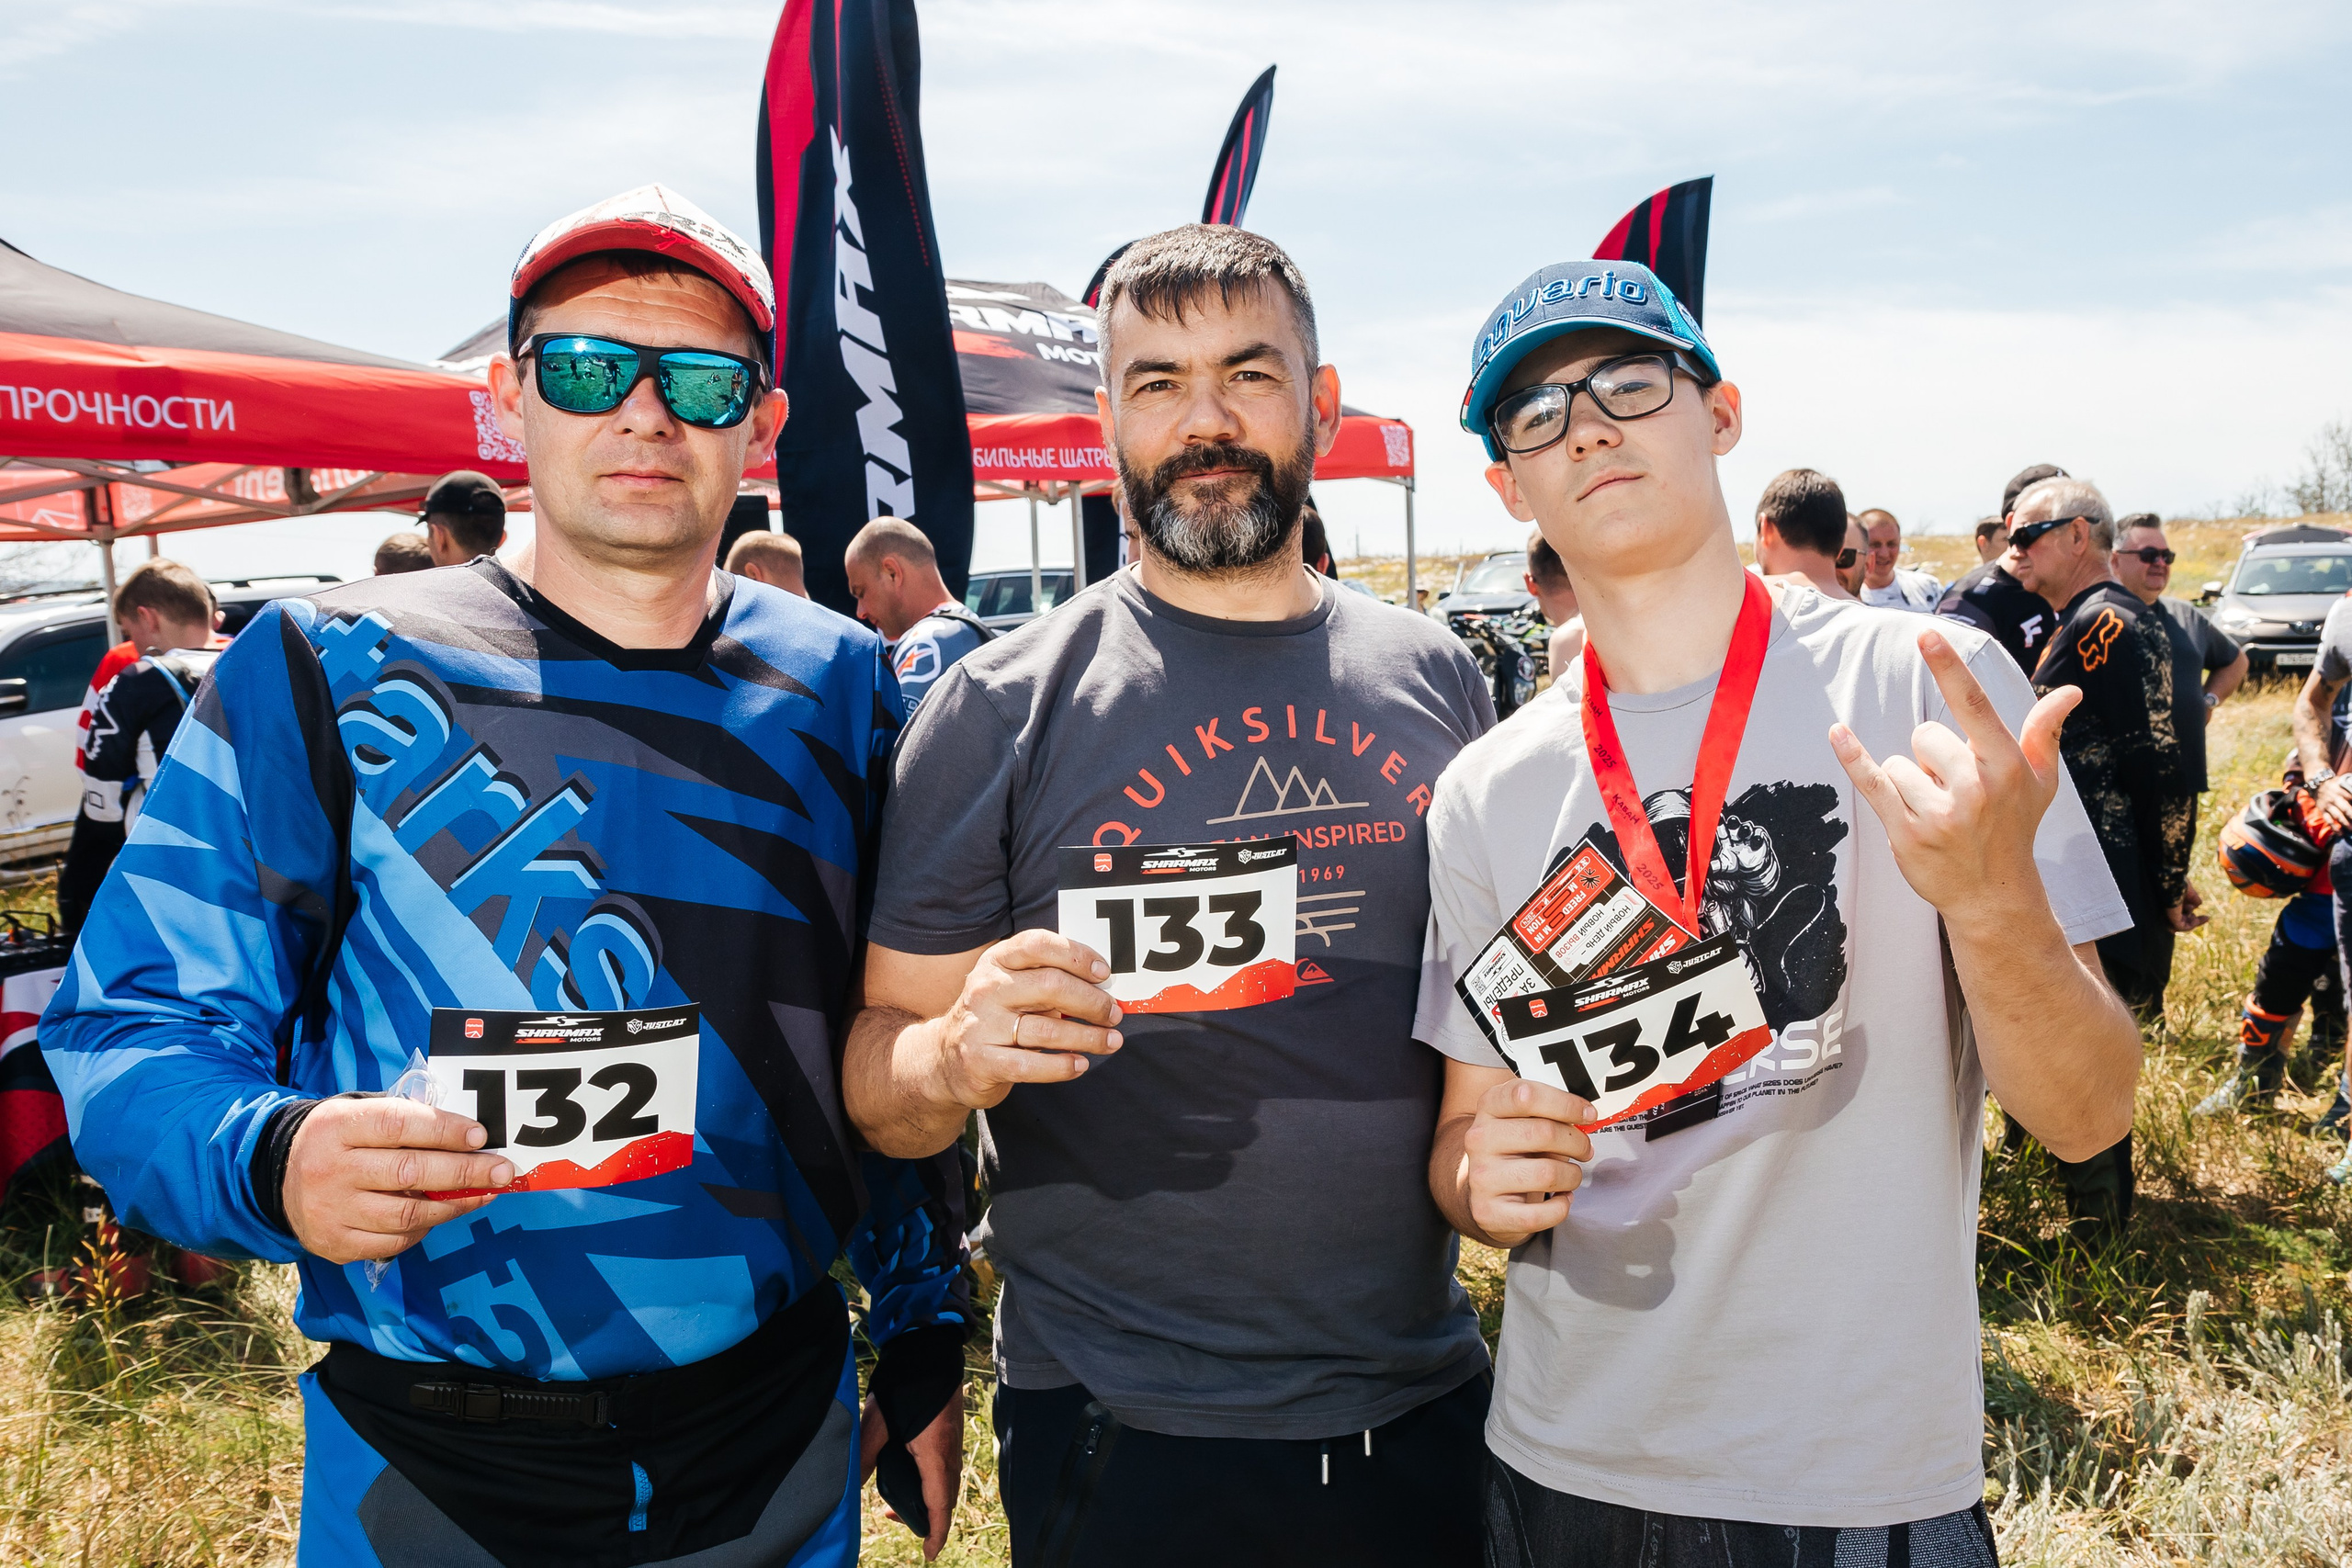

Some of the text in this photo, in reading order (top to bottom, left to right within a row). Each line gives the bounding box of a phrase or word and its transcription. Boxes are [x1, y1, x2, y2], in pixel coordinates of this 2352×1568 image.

[1478, 269, 1648, 366] aquario
[0, 386, 235, 432] ПРОЧНОСТИ
[1594, 744, 1617, 768] 2025
[1092, 705, 1432, 846] QUIKSILVER
[1284, 821, 1407, 851] NSPIRED
[1141, 857, 1219, 869] SHARMAX
[1298, 865, 1345, 884] 1969
[1635, 863, 1664, 890] 2025
[1095, 890, 1266, 975] 133
[1555, 909, 1605, 958] НОВЫЙ ВЫЗОВ
[1603, 905, 1632, 933] НОВЫЙ
[1584, 929, 1606, 951] ДЕНЬ
[1482, 963, 1525, 1010] ПРЕДЕЛЫ
[1519, 976, 1537, 995] ЗА
[1574, 976, 1650, 1008] SHARMAX
[1623, 985, 1650, 998] MOTORS
[514, 1028, 605, 1038] SHARMAX
[1538, 991, 1736, 1101] 134
[462, 1062, 659, 1148] 132
